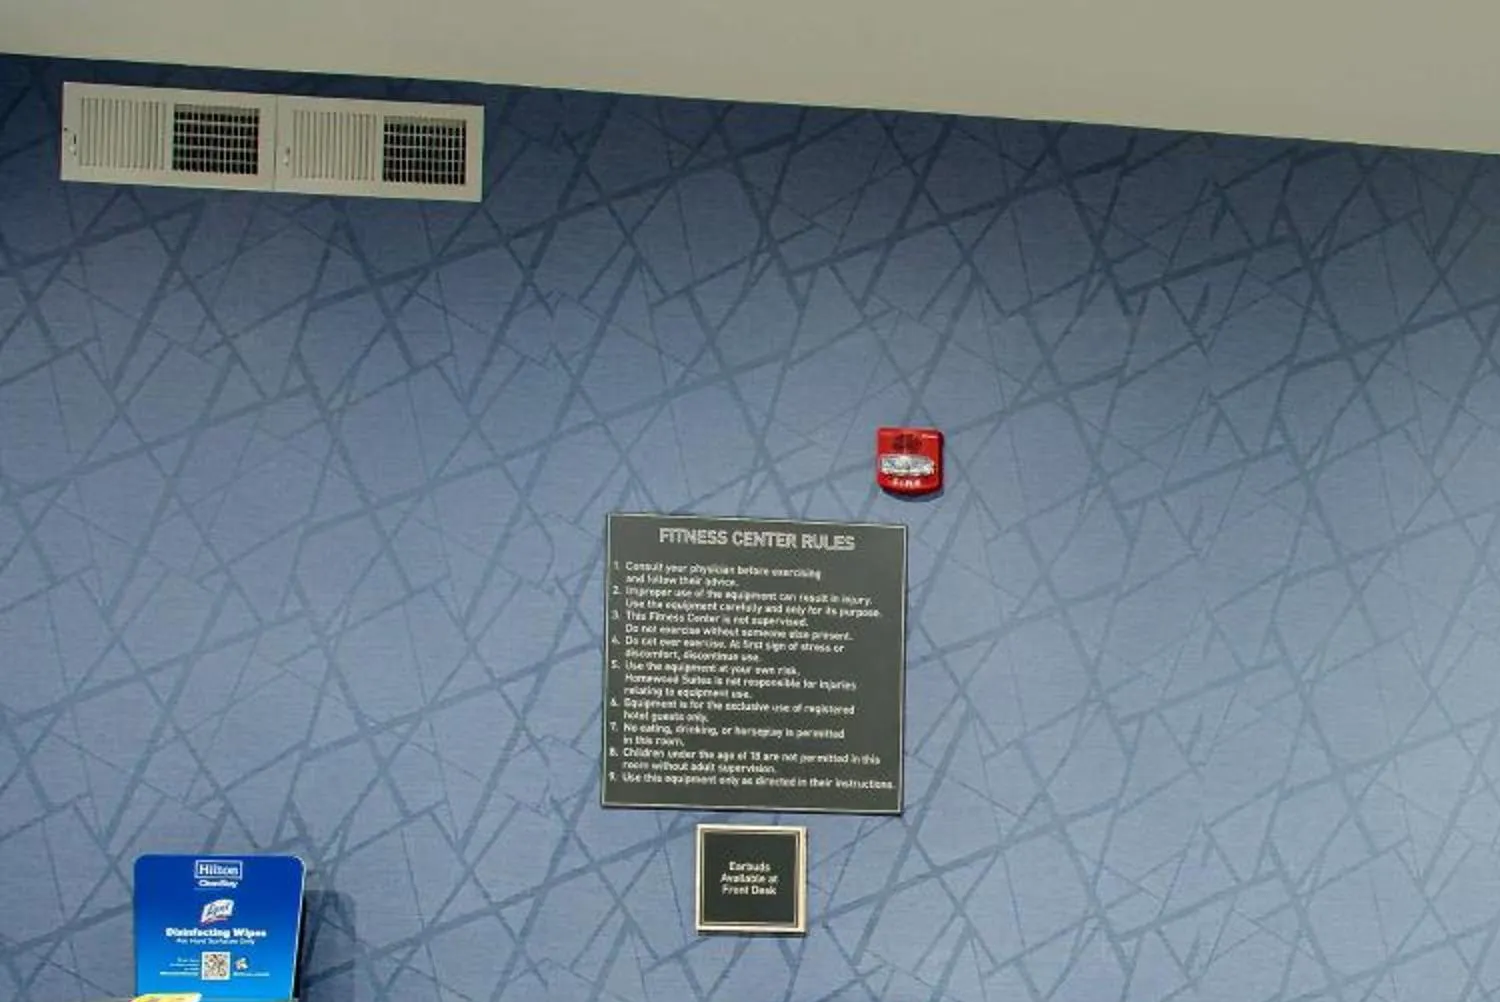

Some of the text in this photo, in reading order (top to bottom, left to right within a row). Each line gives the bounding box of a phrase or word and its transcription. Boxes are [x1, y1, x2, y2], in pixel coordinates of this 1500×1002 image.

[659, 527, 855, 551] FITNESS CENTER RULES
[625, 561, 663, 571] Consult
[665, 564, 687, 574] your
[689, 563, 734, 576] physician
[737, 565, 768, 575] before
[626, 573, 644, 582] and
[647, 574, 675, 583] follow
[679, 575, 702, 584] their
[625, 585, 672, 598] Improper
[675, 589, 692, 597] use
[706, 588, 722, 598] the
[725, 589, 776, 602] equipment
[799, 593, 828, 603] result
[625, 599, 644, 608] Use
[647, 599, 662, 608] the
[665, 600, 716, 612] equipment
[719, 602, 762, 614] carefully
[764, 604, 782, 612] and
[785, 605, 806, 616] only
[807, 606, 822, 615] for
[627, 610, 646, 620] This
[649, 611, 684, 622] Fitness
[687, 612, 720, 623] Center
[733, 614, 749, 624] not
[641, 624, 656, 633] not
[659, 624, 700, 635] exercise
[703, 626, 738, 636] without
[741, 629, 786, 637] someone
[641, 636, 656, 645] not
[743, 639, 762, 649] first
[765, 640, 786, 652] sign
[800, 642, 831, 652] stress
[683, 650, 738, 660] discontinue
[624, 660, 644, 670] Use
[646, 660, 662, 670] the
[664, 661, 716, 673] equipment
[731, 665, 751, 674] your
[755, 666, 774, 674] own
[777, 665, 800, 674] risk.
[725, 676, 740, 685] not
[743, 676, 800, 689] responsible
[803, 679, 817, 688] for
[819, 680, 856, 692] injuries
[677, 687, 728, 699] equipment
[623, 697, 676, 710] Equipment
[690, 699, 704, 709] for
[706, 700, 722, 709] the
[725, 700, 769, 710] exclusive
[772, 703, 789, 711] use
[804, 704, 854, 716] registered
[623, 709, 648, 719] hotel
[686, 711, 708, 723] only.
[640, 722, 672, 735] eating,
[675, 723, 718, 736] drinking,
[796, 728, 844, 740] permitted
[635, 736, 652, 744] this
[623, 748, 664, 757] Children
[667, 749, 696, 758] under
[698, 750, 714, 759] the
[717, 752, 734, 761] age
[781, 752, 797, 761] not
[799, 753, 848, 765] permitted
[861, 755, 880, 764] this
[623, 761, 775, 774] room without adult supervision.
[622, 772, 640, 782] Use
[643, 773, 662, 782] this
[664, 773, 716, 785] equipment
[718, 775, 740, 785] only
[755, 775, 796, 785] directed
[809, 778, 832, 787] their
[834, 778, 895, 788] instructions.
[199, 864, 239, 876] Hilton
[729, 861, 771, 872] Earbuds
[720, 873, 778, 883] Available at
[722, 885, 777, 895] Front Desk
[165, 927, 267, 938] Disinfecting Wipes
